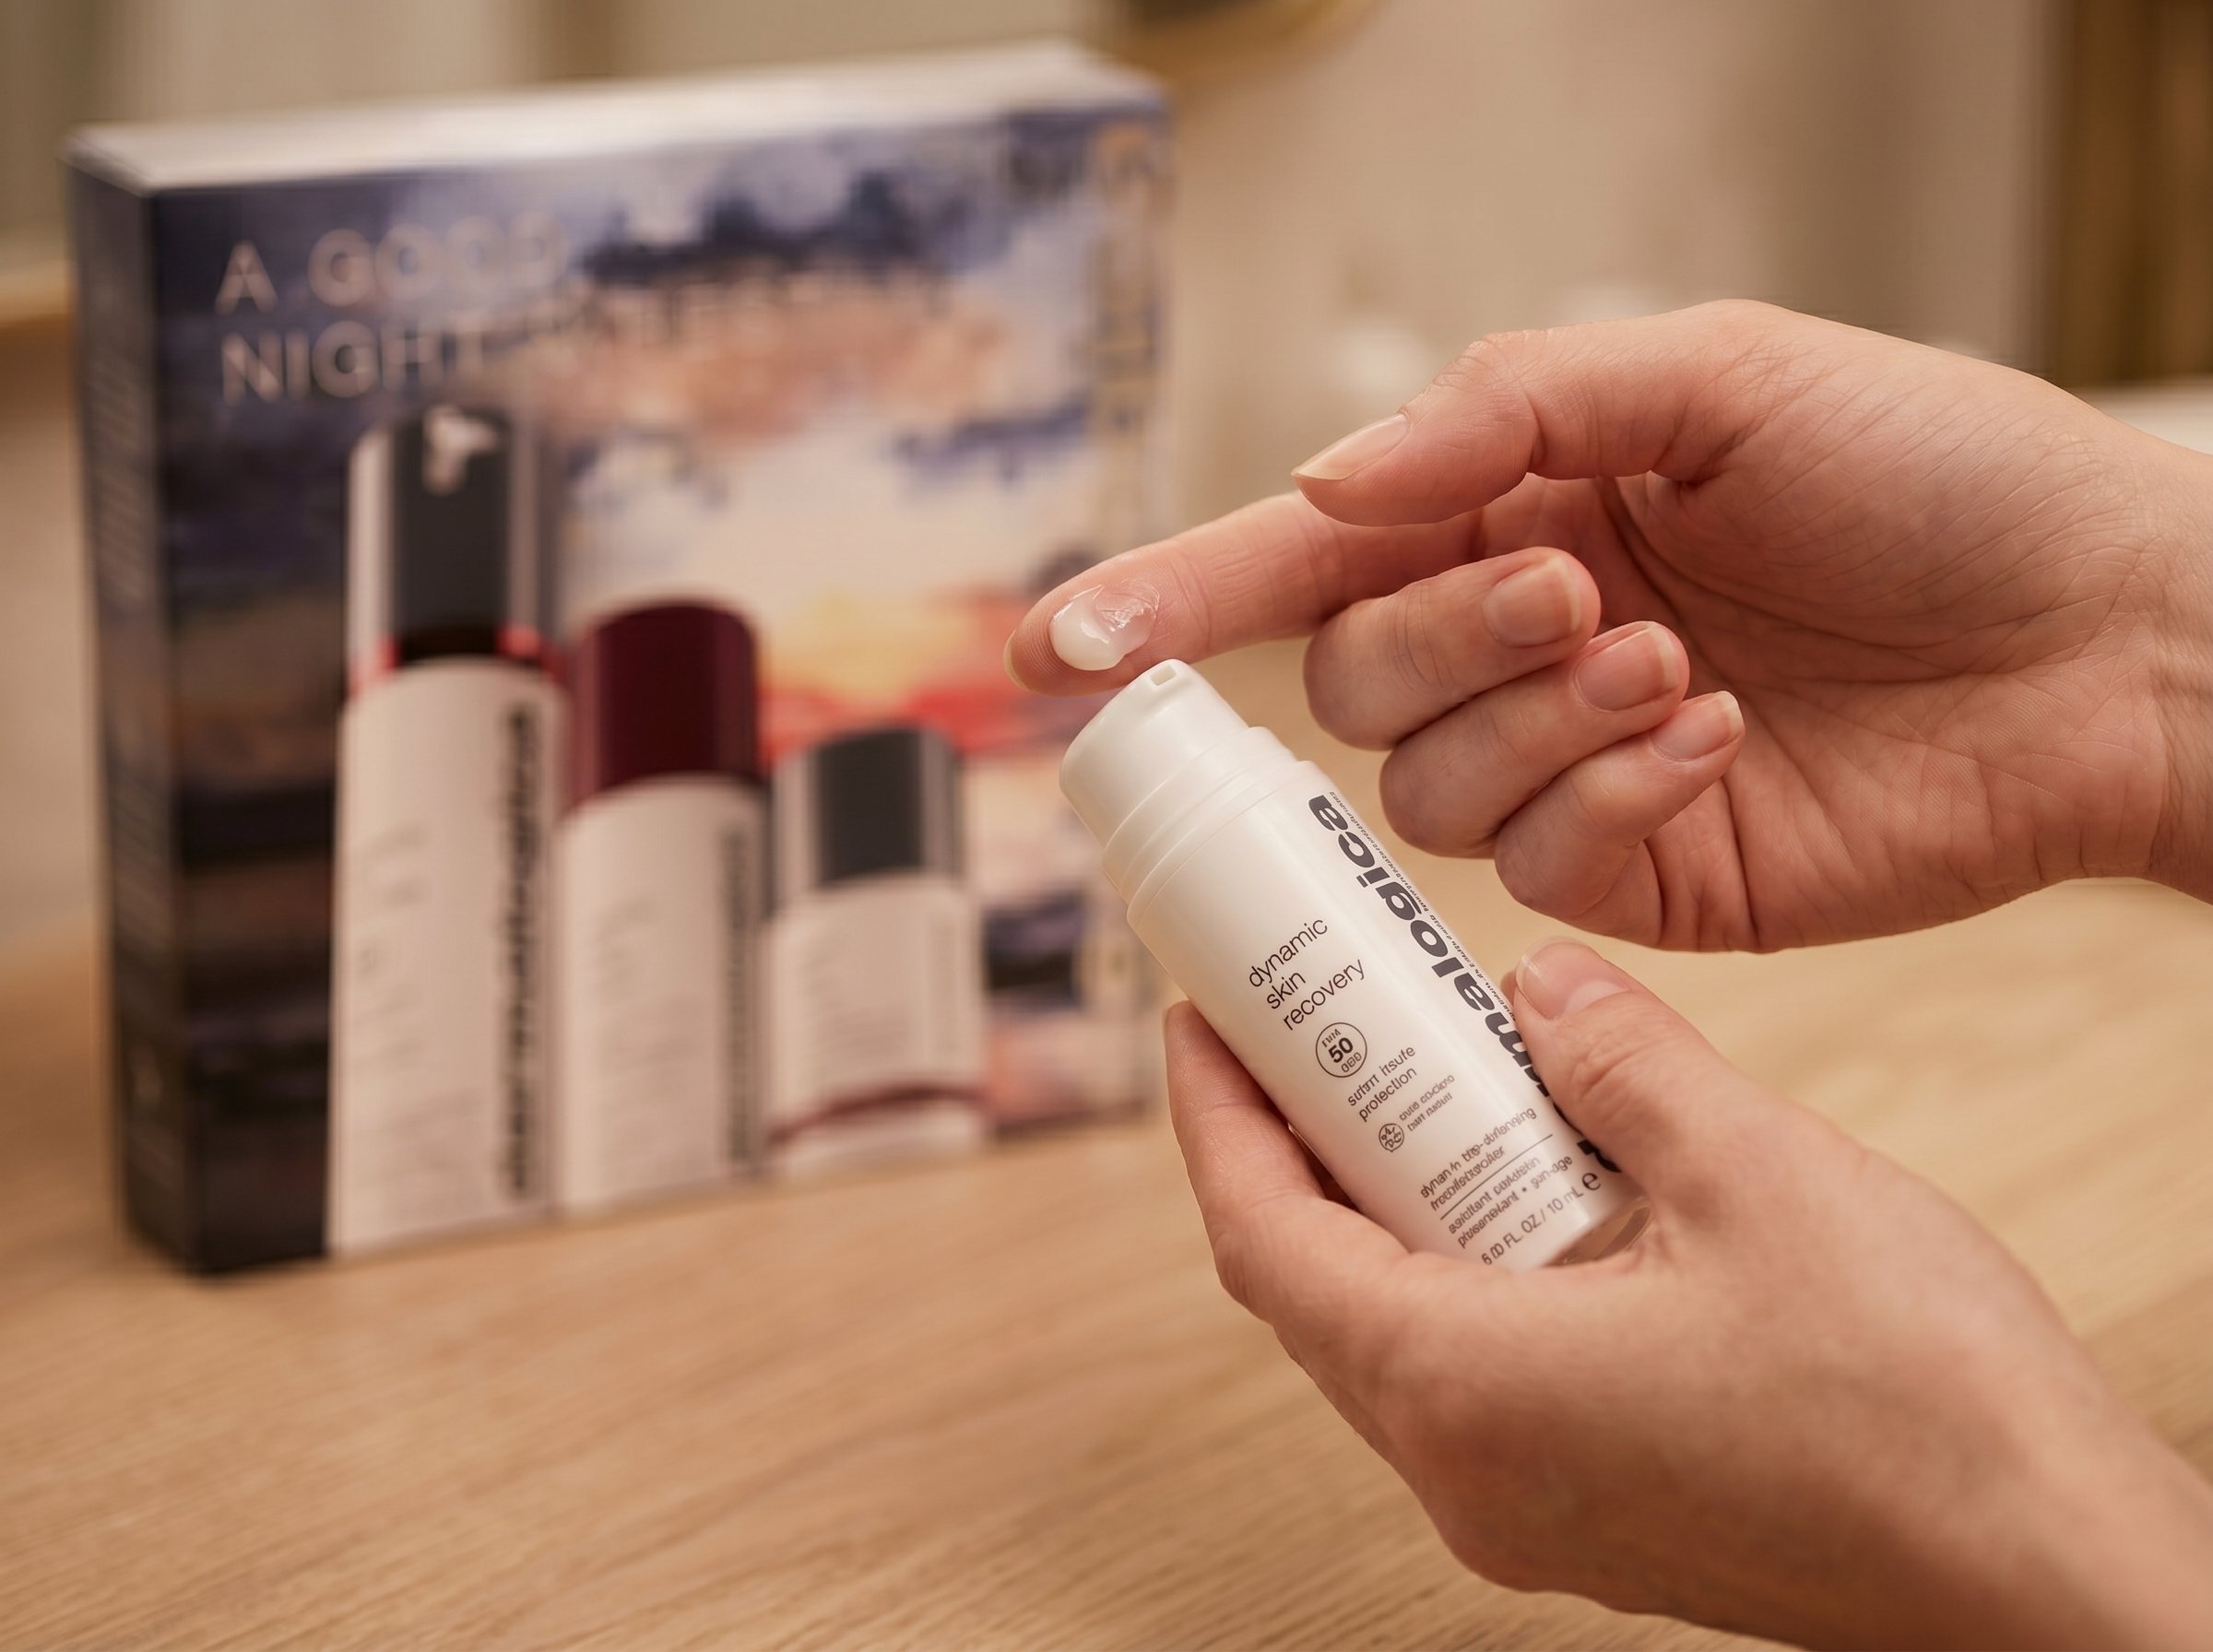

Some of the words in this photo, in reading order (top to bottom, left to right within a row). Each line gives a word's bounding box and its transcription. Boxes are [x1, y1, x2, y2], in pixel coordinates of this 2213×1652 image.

[214, 240, 278, 316] A
[307, 210, 570, 308] GOOD
[1249, 919, 1328, 987] dynamic
[1266, 972, 1307, 1009] skin
[1283, 959, 1365, 1031] recovery
[1328, 1036, 1354, 1063] 50
[1521, 1213, 1544, 1234] OZ
[1546, 1197, 1564, 1215] 10
